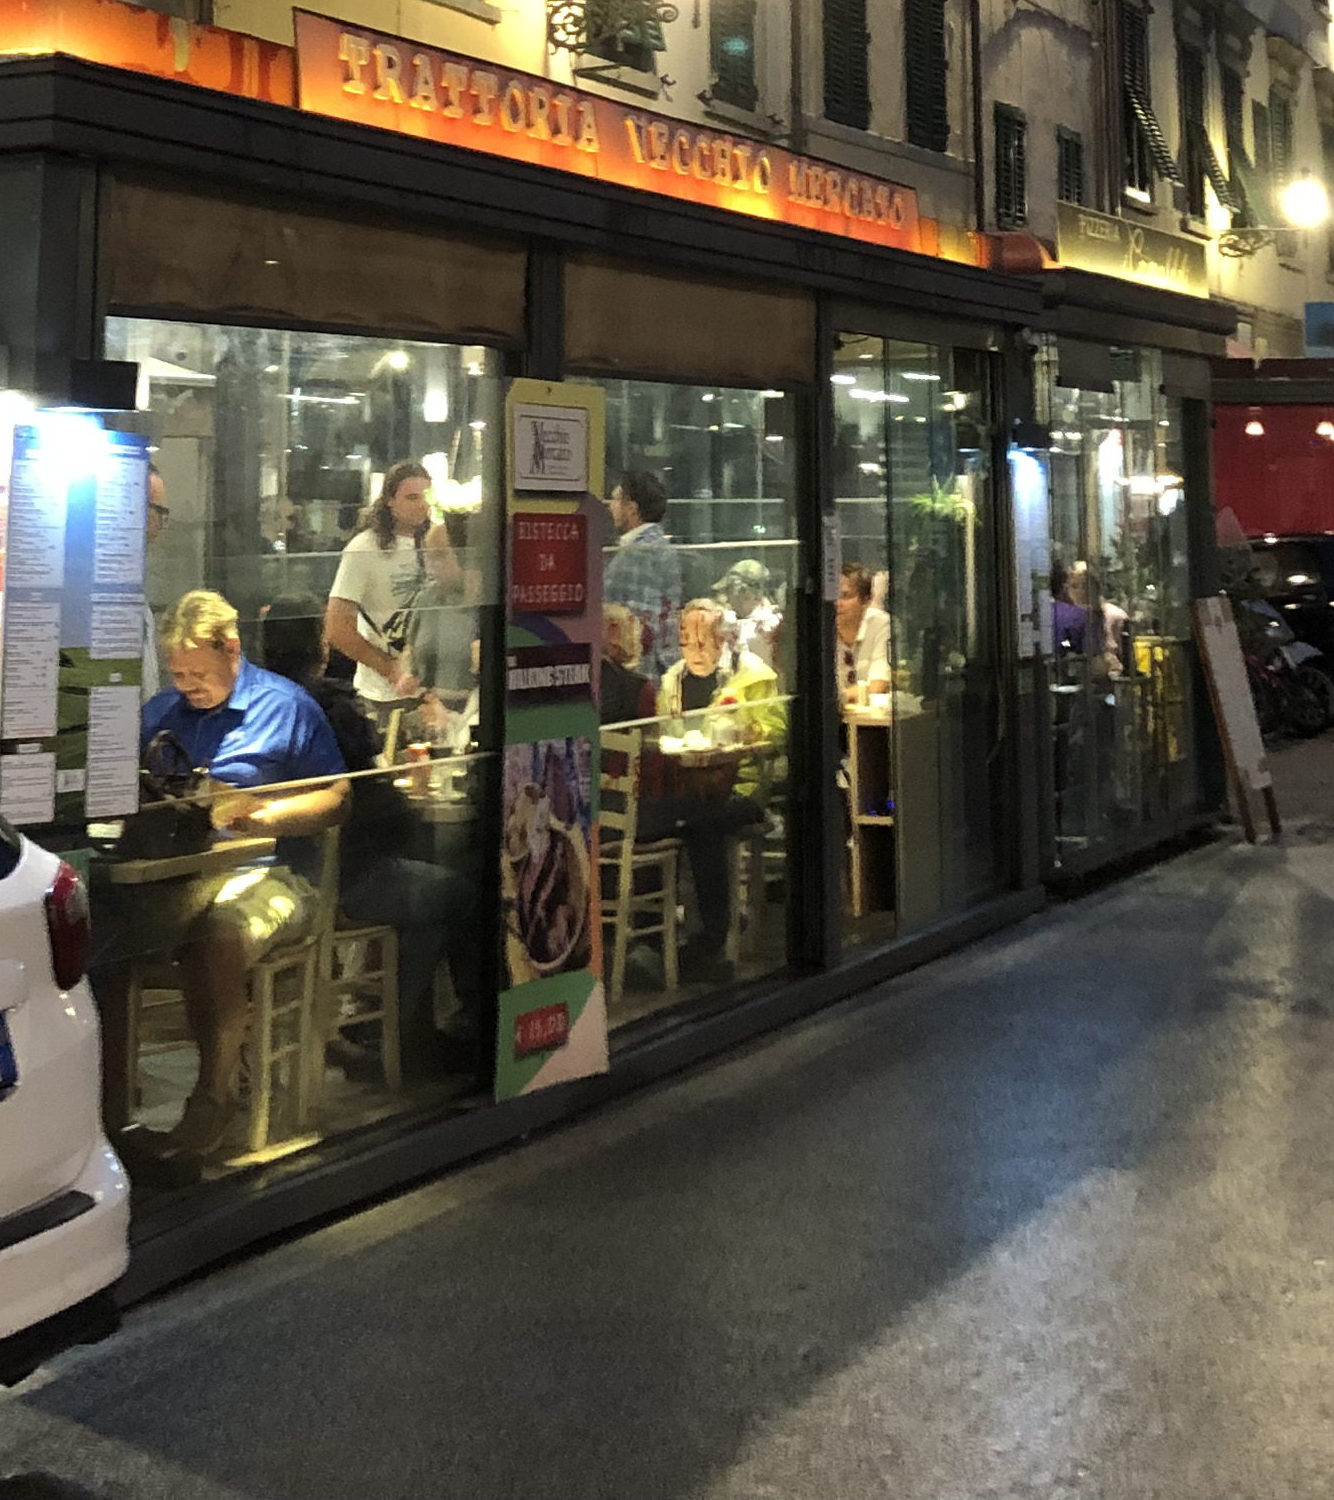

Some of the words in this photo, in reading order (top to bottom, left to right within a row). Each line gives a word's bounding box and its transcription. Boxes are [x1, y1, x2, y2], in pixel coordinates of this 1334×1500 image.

[339, 32, 600, 153] TRATTORIA
[622, 114, 773, 194] VECCHIO
[786, 157, 907, 229] MERCATO
[519, 521, 580, 541] BISTECCA
[538, 553, 557, 572] DA
[512, 583, 584, 604] PASSEGGIO
